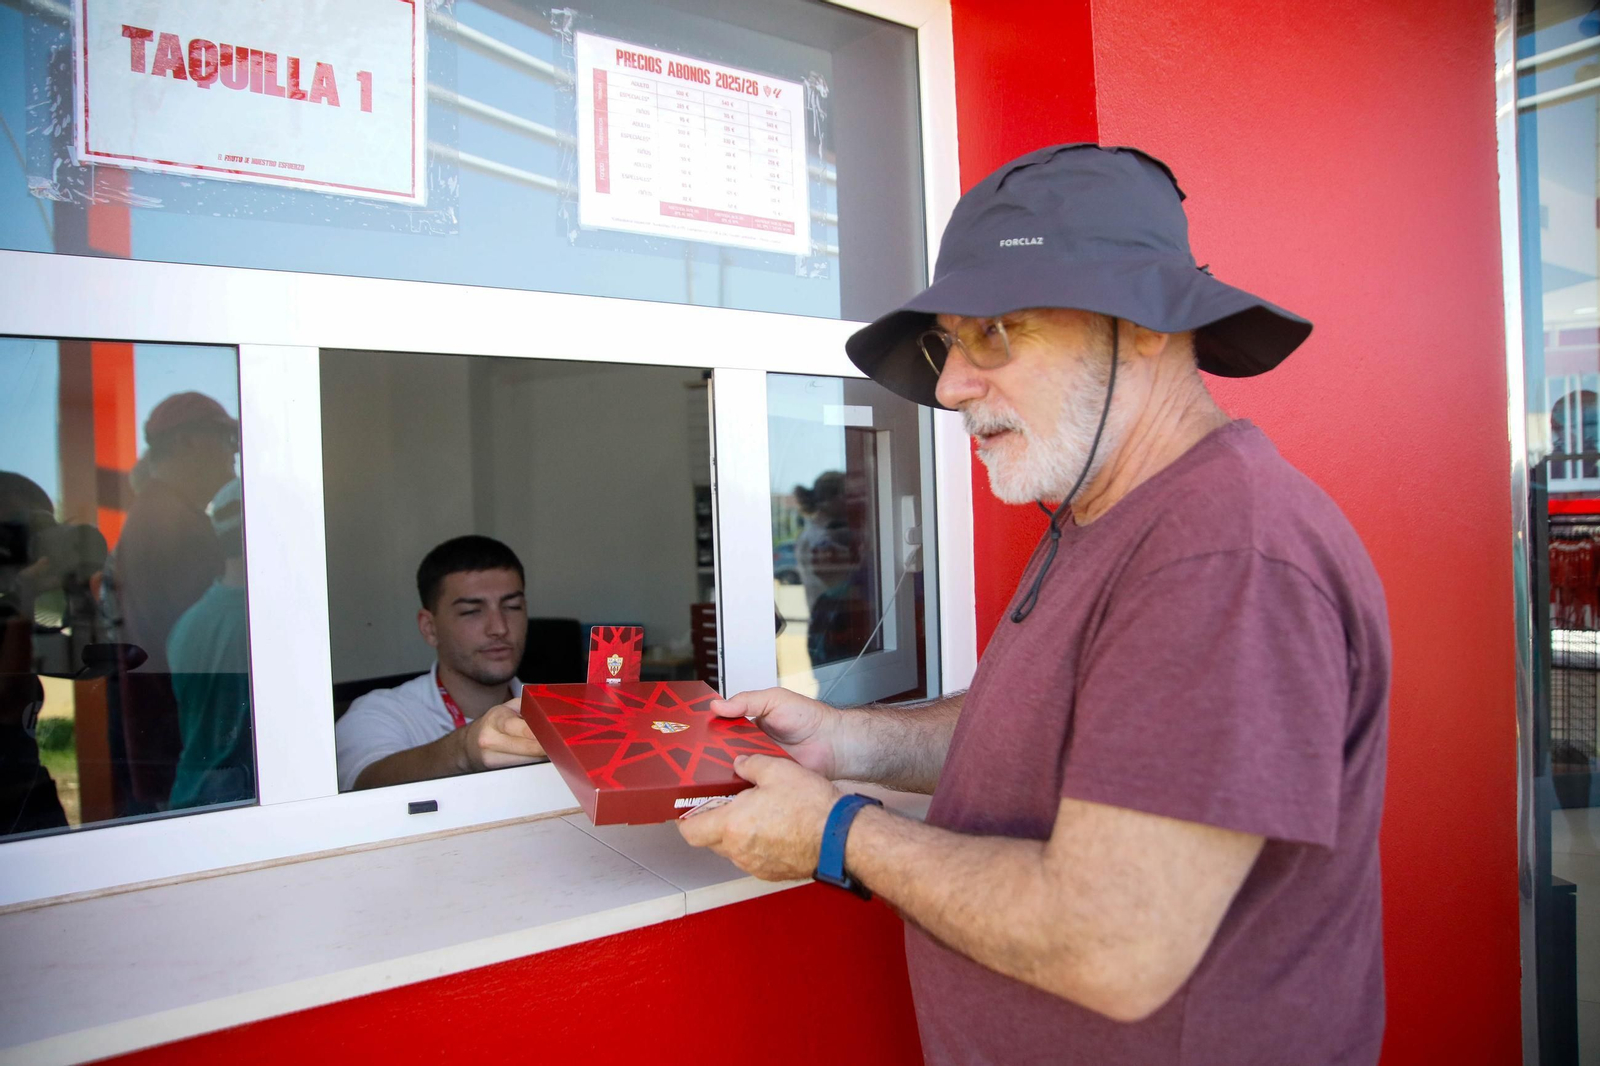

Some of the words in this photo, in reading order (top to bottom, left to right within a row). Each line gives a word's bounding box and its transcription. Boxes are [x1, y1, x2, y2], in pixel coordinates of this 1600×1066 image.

[121, 24, 340, 107] TAQUILLA
[356, 70, 373, 113] 1
[615, 48, 663, 75] PRECIOS
[667, 60, 711, 86] ABONOS
[715, 71, 759, 97] 2025/26
[251, 158, 277, 167] NUESTRO
[278, 161, 305, 171] ESFUERZO
[1000, 237, 1044, 247] FORCLAZ
